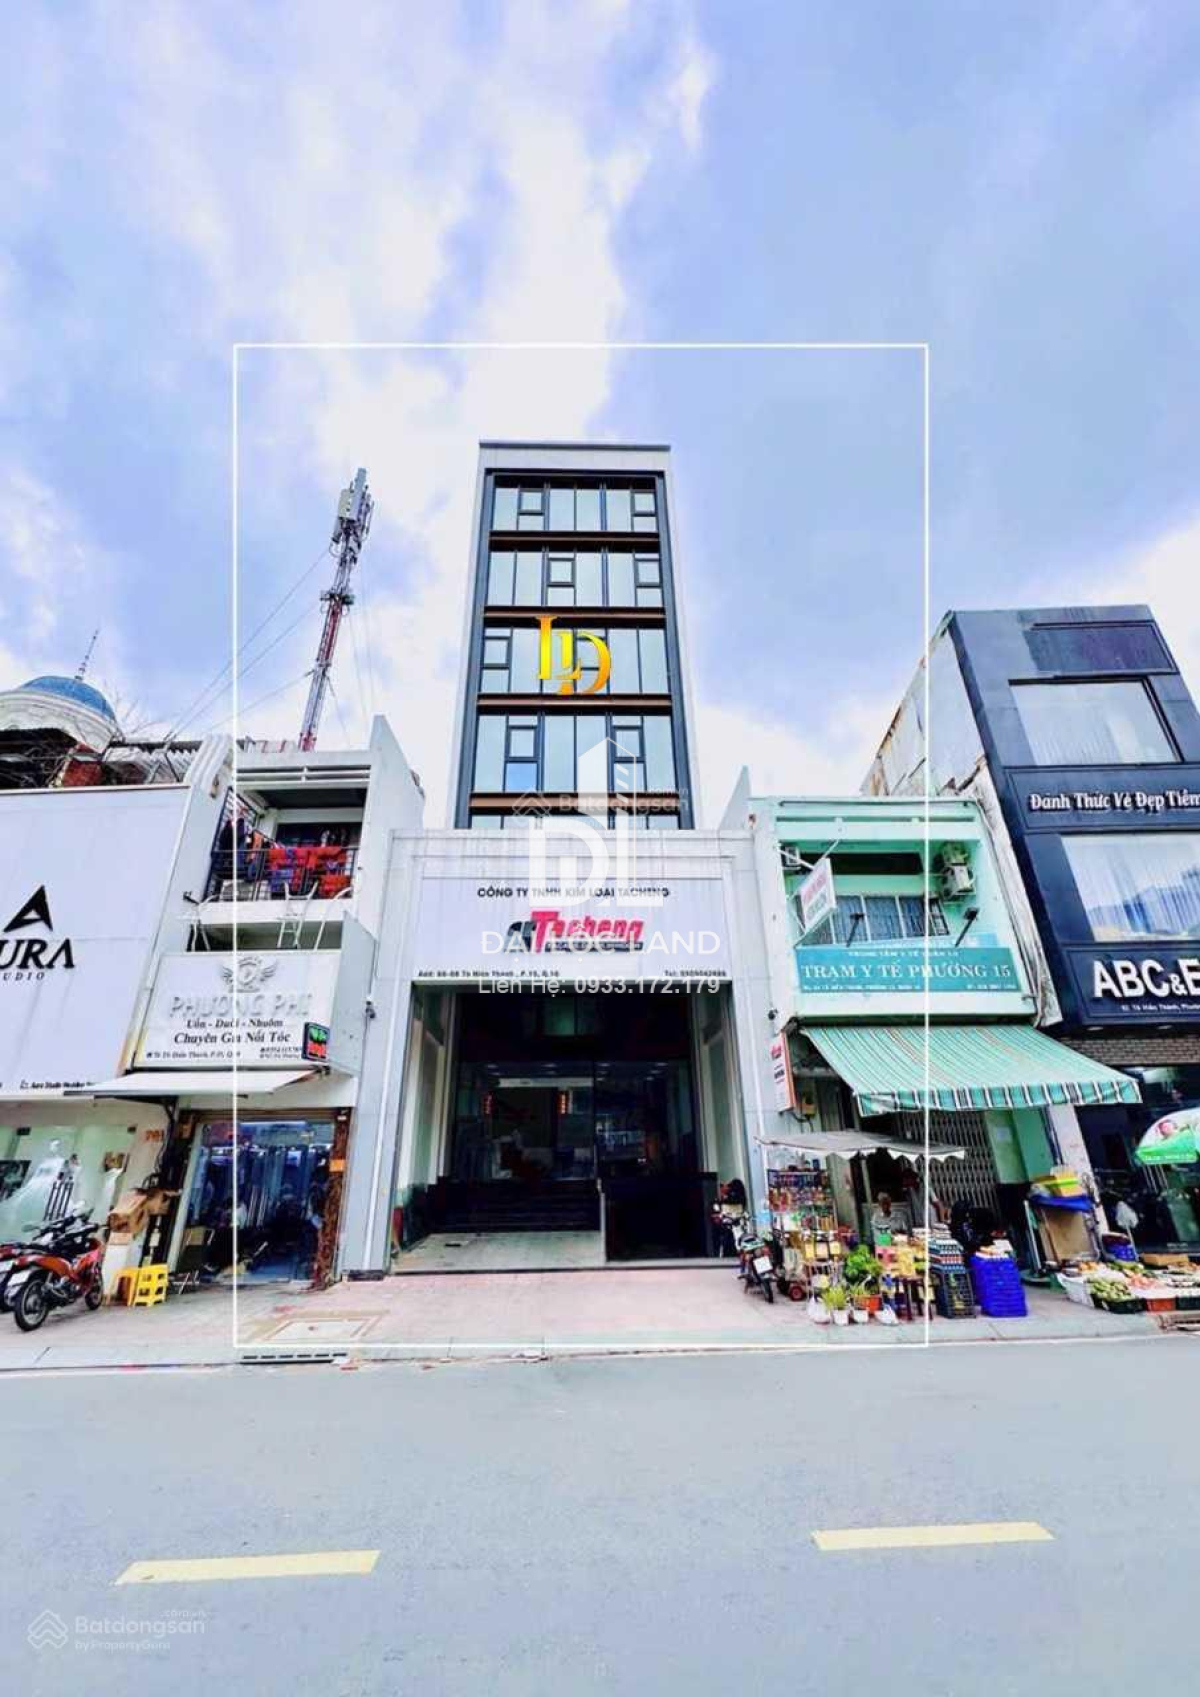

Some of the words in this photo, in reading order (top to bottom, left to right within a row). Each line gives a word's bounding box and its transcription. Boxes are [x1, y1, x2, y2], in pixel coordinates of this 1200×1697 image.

[477, 884, 513, 898] CÔNG
[516, 887, 529, 897] TY
[532, 887, 562, 897] TNHH
[618, 887, 670, 897] TACHENG
[530, 909, 644, 953] Tacheng
[860, 964, 872, 978] Y
[877, 957, 903, 978] TẾ
[993, 964, 1011, 978] 15
